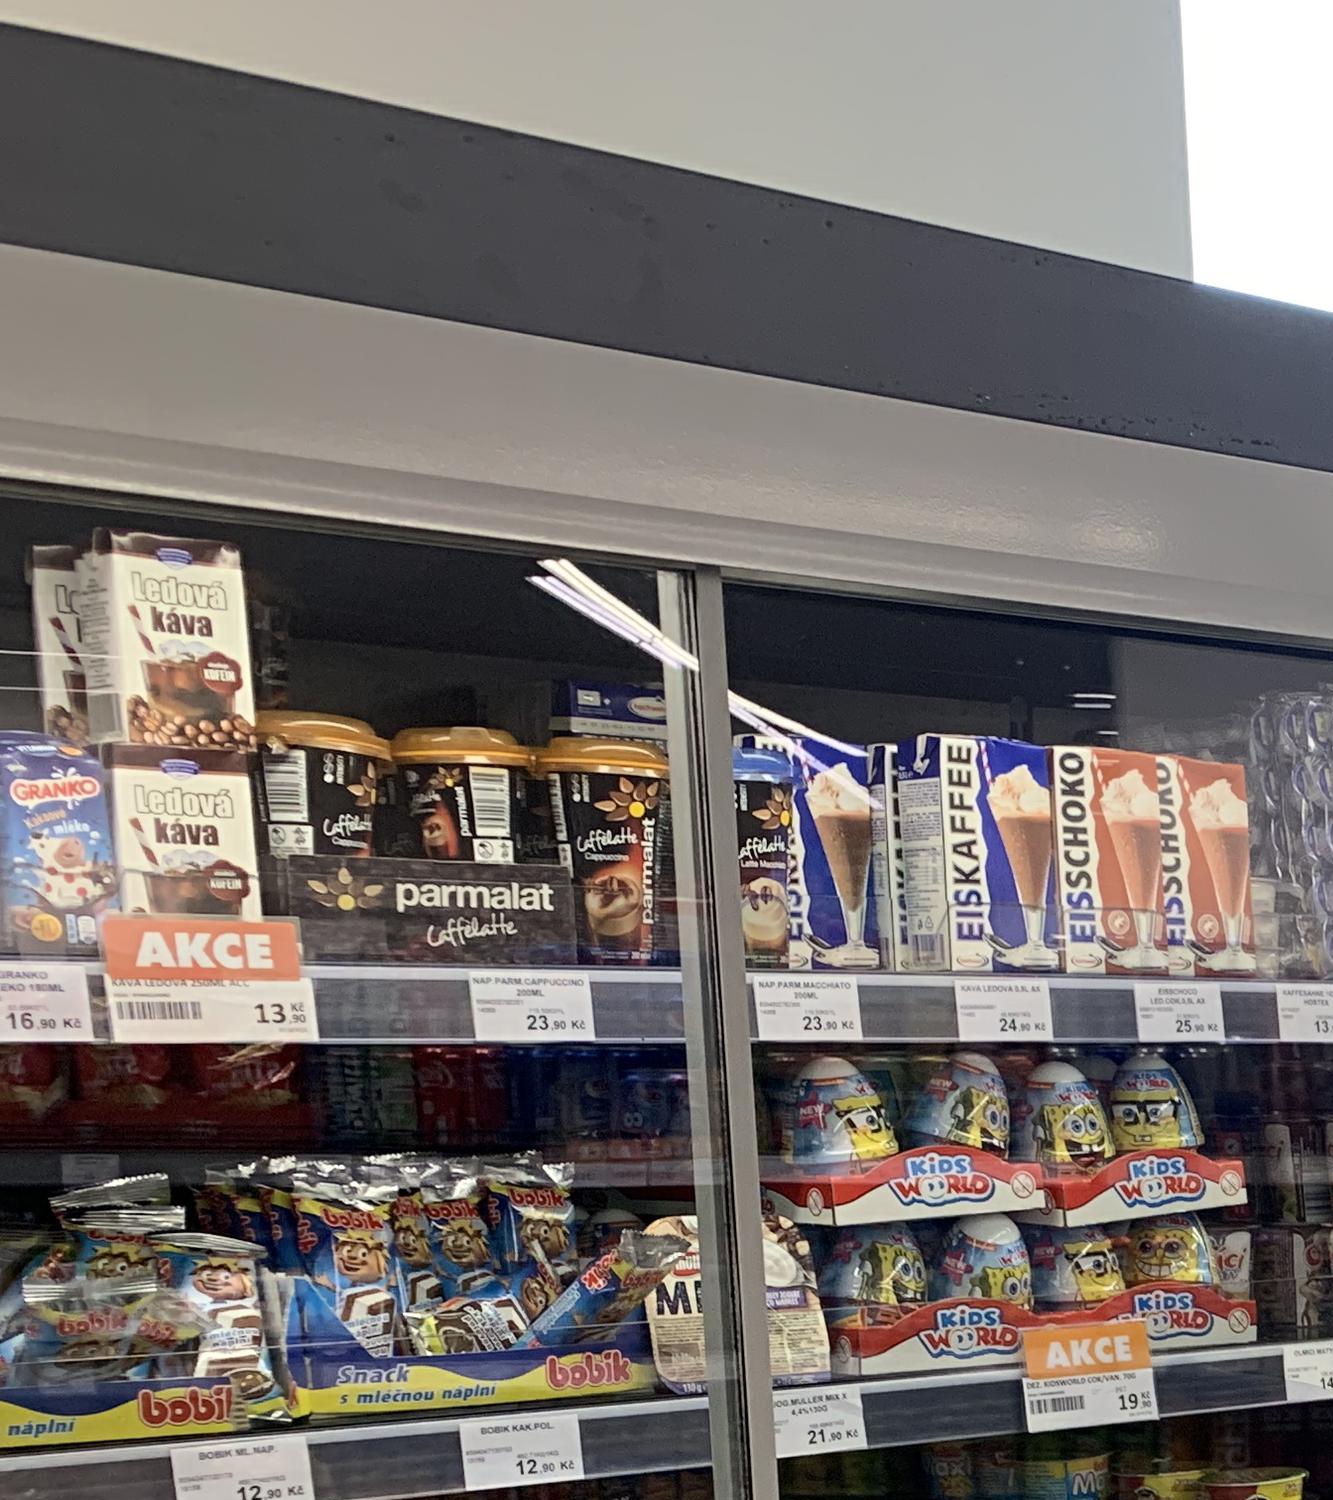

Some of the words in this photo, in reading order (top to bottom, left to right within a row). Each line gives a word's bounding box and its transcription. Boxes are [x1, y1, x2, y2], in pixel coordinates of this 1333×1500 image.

[131, 571, 228, 611] Ledová
[151, 606, 214, 638] káva
[203, 668, 237, 682] KOFEIN
[11, 779, 98, 801] GRANKO
[134, 784, 234, 818] Ledová
[454, 785, 473, 837] parmalat
[154, 818, 220, 847] káva
[946, 743, 985, 942] EISKAFFEE
[1058, 751, 1098, 944] EISSCHOKO
[642, 817, 657, 925] parmalat
[396, 881, 555, 913] parmalat
[135, 931, 275, 970] AKCE
[516, 987, 545, 998] 200ML
[64, 1017, 82, 1030] Kč
[571, 1019, 586, 1031] Kč
[841, 1018, 855, 1030] Kč
[1034, 1021, 1047, 1032] Kč
[425, 1199, 478, 1220] bobik
[508, 1188, 567, 1208] bobik
[324, 1207, 385, 1232] bobik
[1045, 1334, 1133, 1369] AKCE
[337, 1362, 410, 1386] Snack
[545, 1349, 632, 1391] bobik
[340, 1393, 348, 1405] s
[355, 1387, 434, 1406] mléčnou
[442, 1383, 496, 1402] náplní
[7, 1417, 76, 1439] náplní
[845, 1429, 860, 1441] Kč
[560, 1460, 575, 1472] Kč
[287, 1483, 305, 1497] Kč
